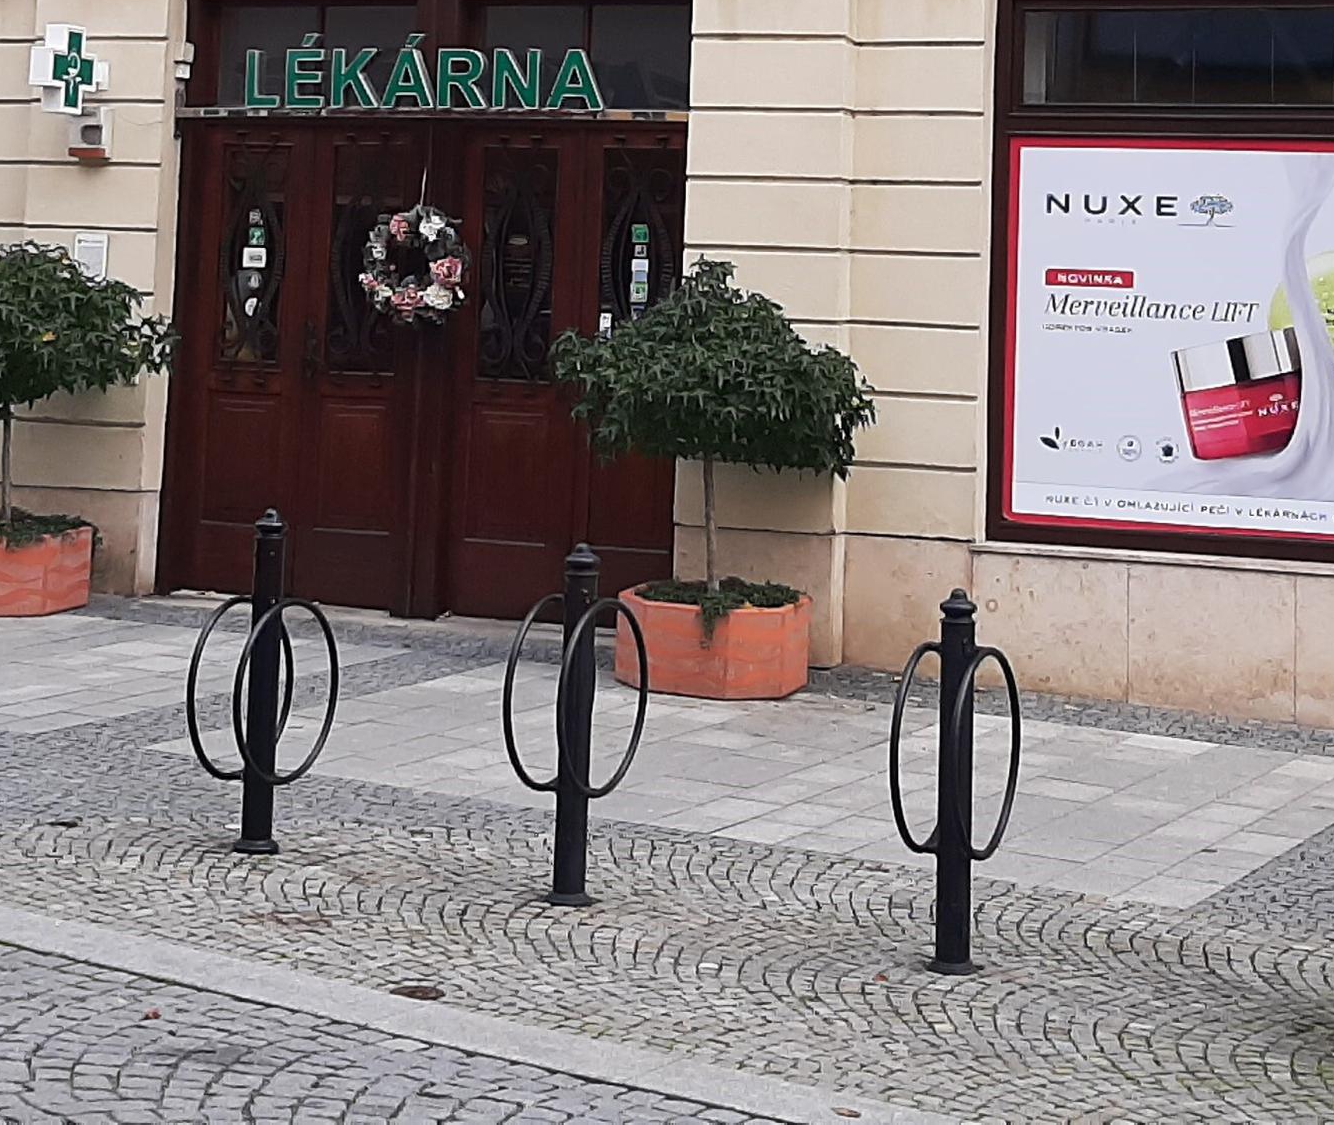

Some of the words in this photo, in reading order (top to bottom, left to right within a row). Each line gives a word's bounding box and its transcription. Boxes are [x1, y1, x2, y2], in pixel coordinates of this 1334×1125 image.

[245, 33, 604, 110] LÉKÁRNA
[1046, 193, 1178, 216] NUXE
[1057, 273, 1123, 286] NOVINKA
[1044, 293, 1205, 321] Merveillance
[1211, 301, 1260, 323] LIFT
